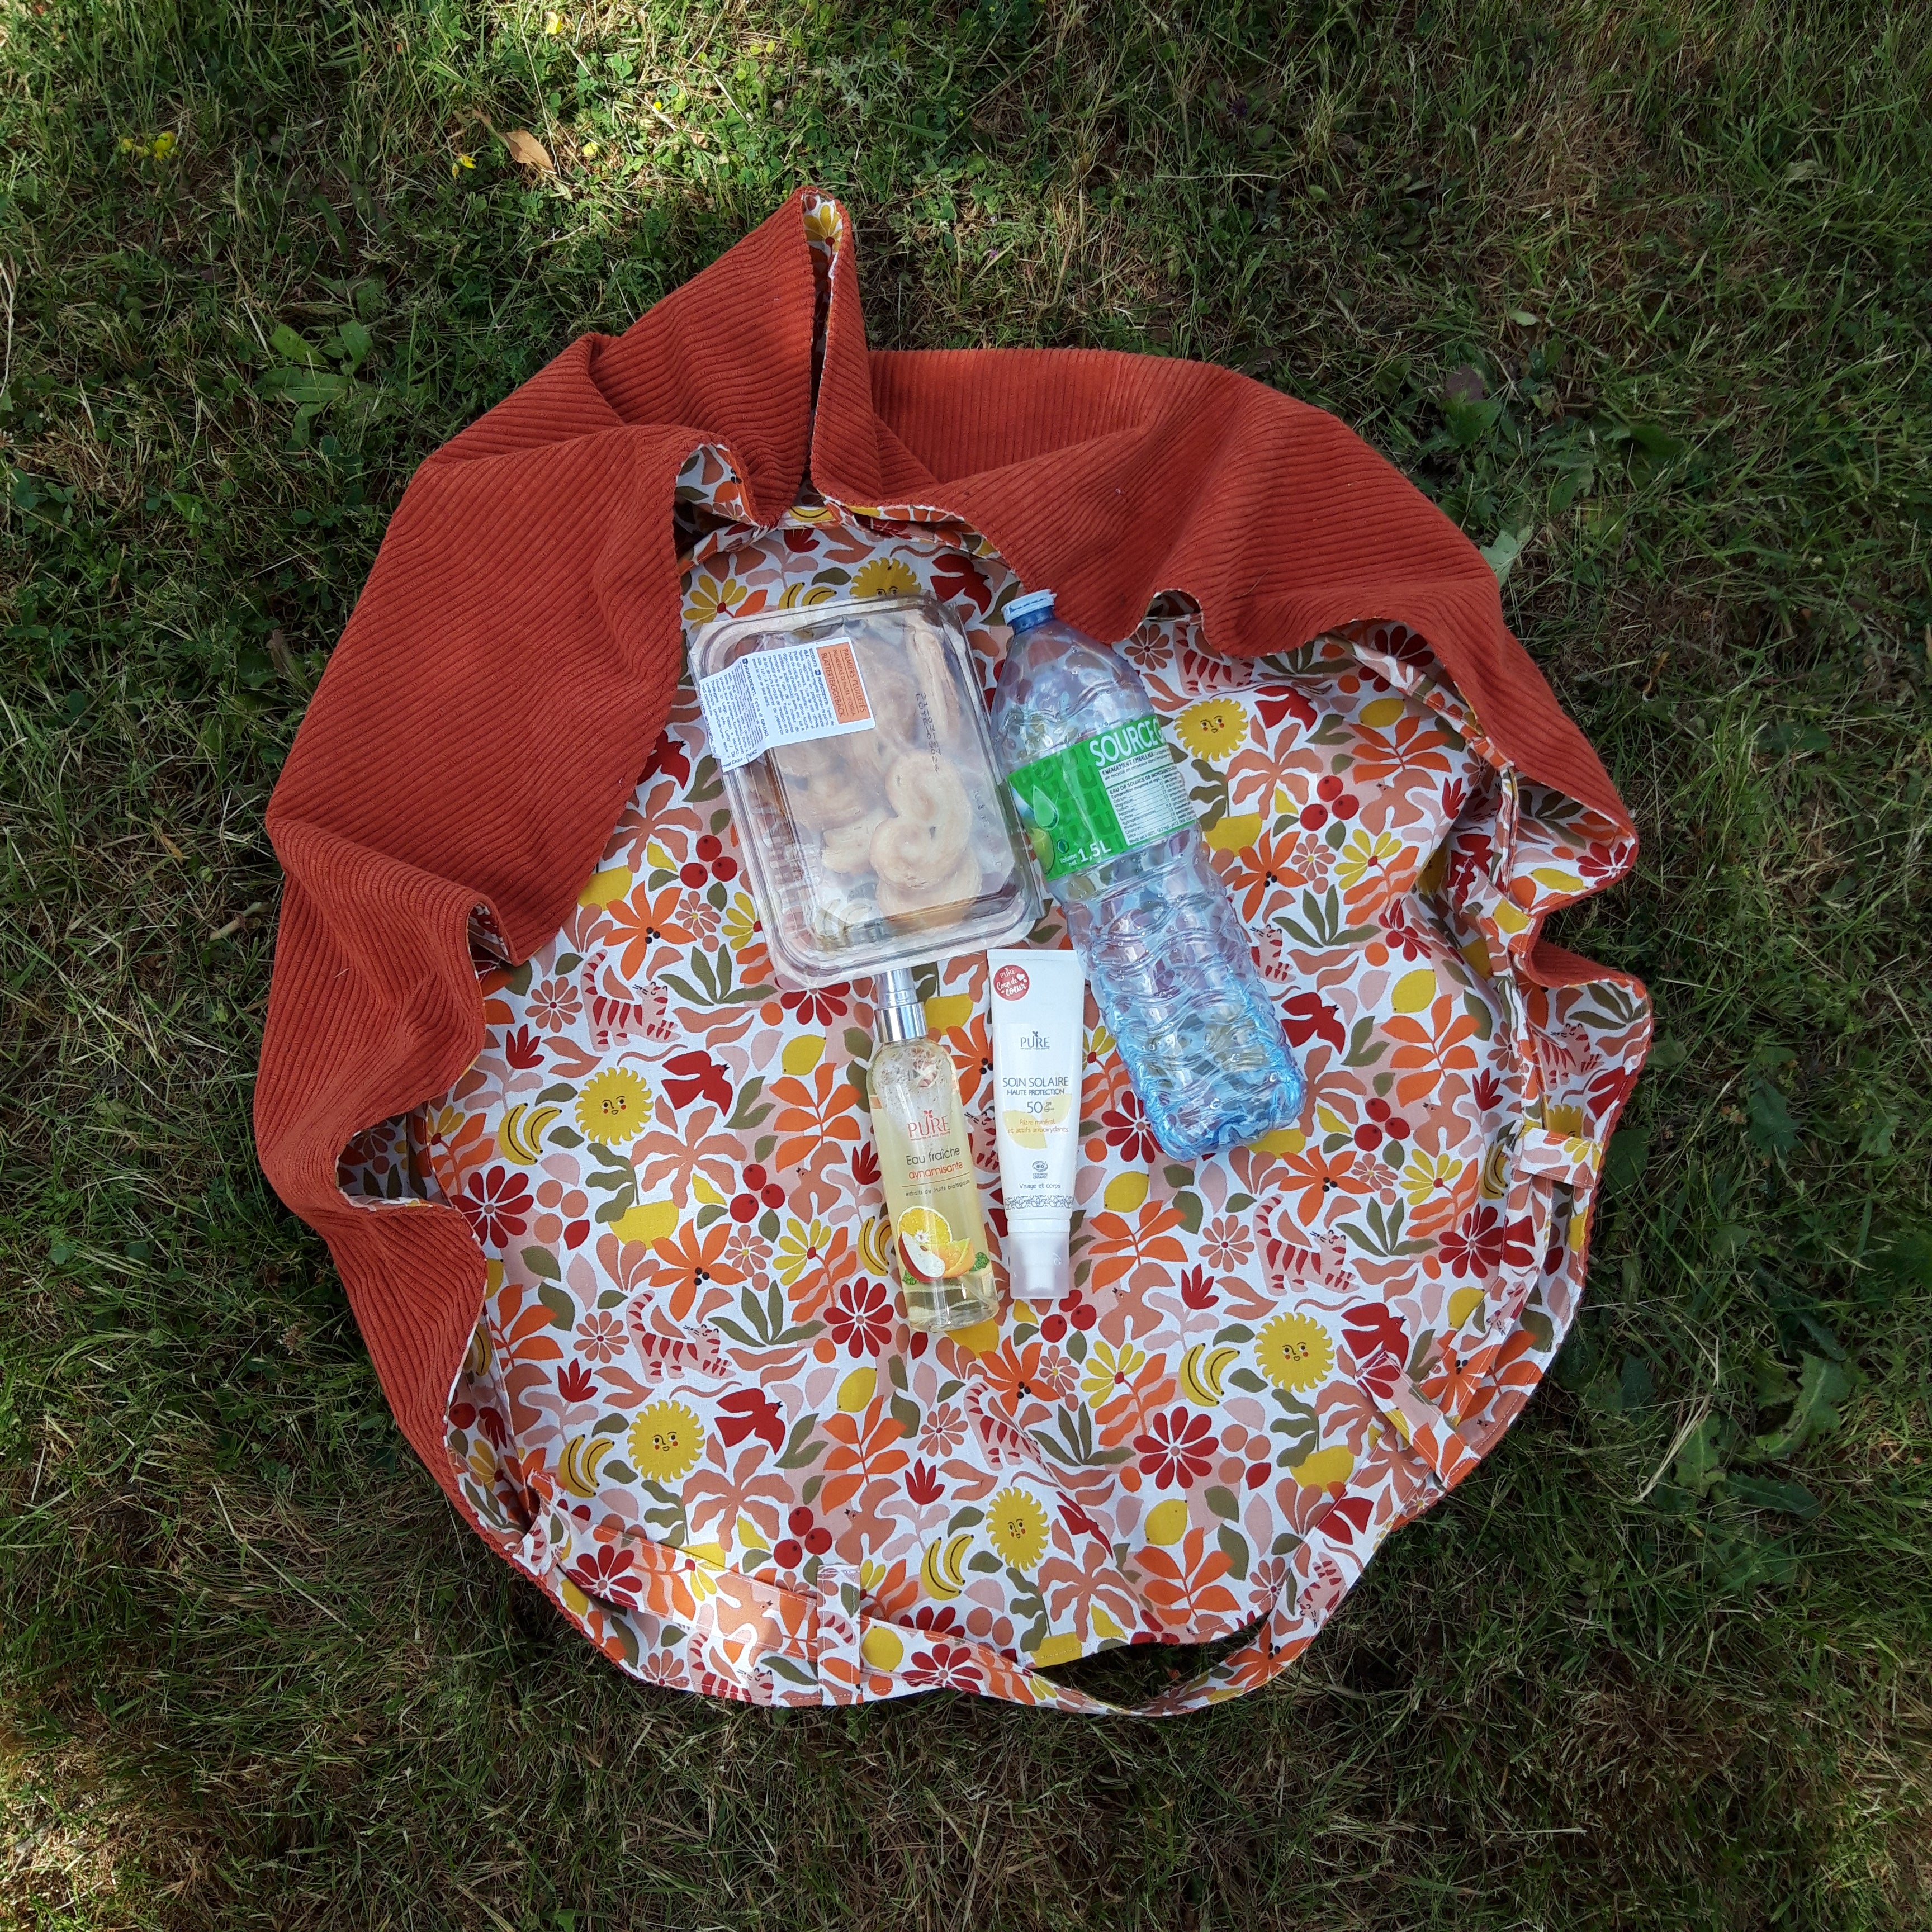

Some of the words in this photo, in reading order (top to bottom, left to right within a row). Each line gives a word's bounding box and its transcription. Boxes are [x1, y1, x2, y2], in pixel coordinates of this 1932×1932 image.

[842, 648, 856, 678] PALMIERS
[851, 679, 866, 713] FEUILLETÉS
[1090, 721, 1156, 767] SOURCE
[1102, 759, 1131, 775] ENGAGEMENT
[1126, 776, 1145, 787] SOURCE
[1000, 968, 1016, 978] PURE
[996, 981, 1011, 991] Coup
[1011, 977, 1019, 986] de
[1020, 1034, 1050, 1048] PURE
[1002, 1077, 1026, 1087] SOIN
[1029, 1076, 1069, 1087] SOLAIRE
[1026, 1101, 1043, 1114] 50
[907, 1114, 951, 1138] PURE
[906, 1153, 926, 1166] Eau
[928, 1147, 961, 1162] fraîche
[908, 1161, 963, 1180] dynamisante
